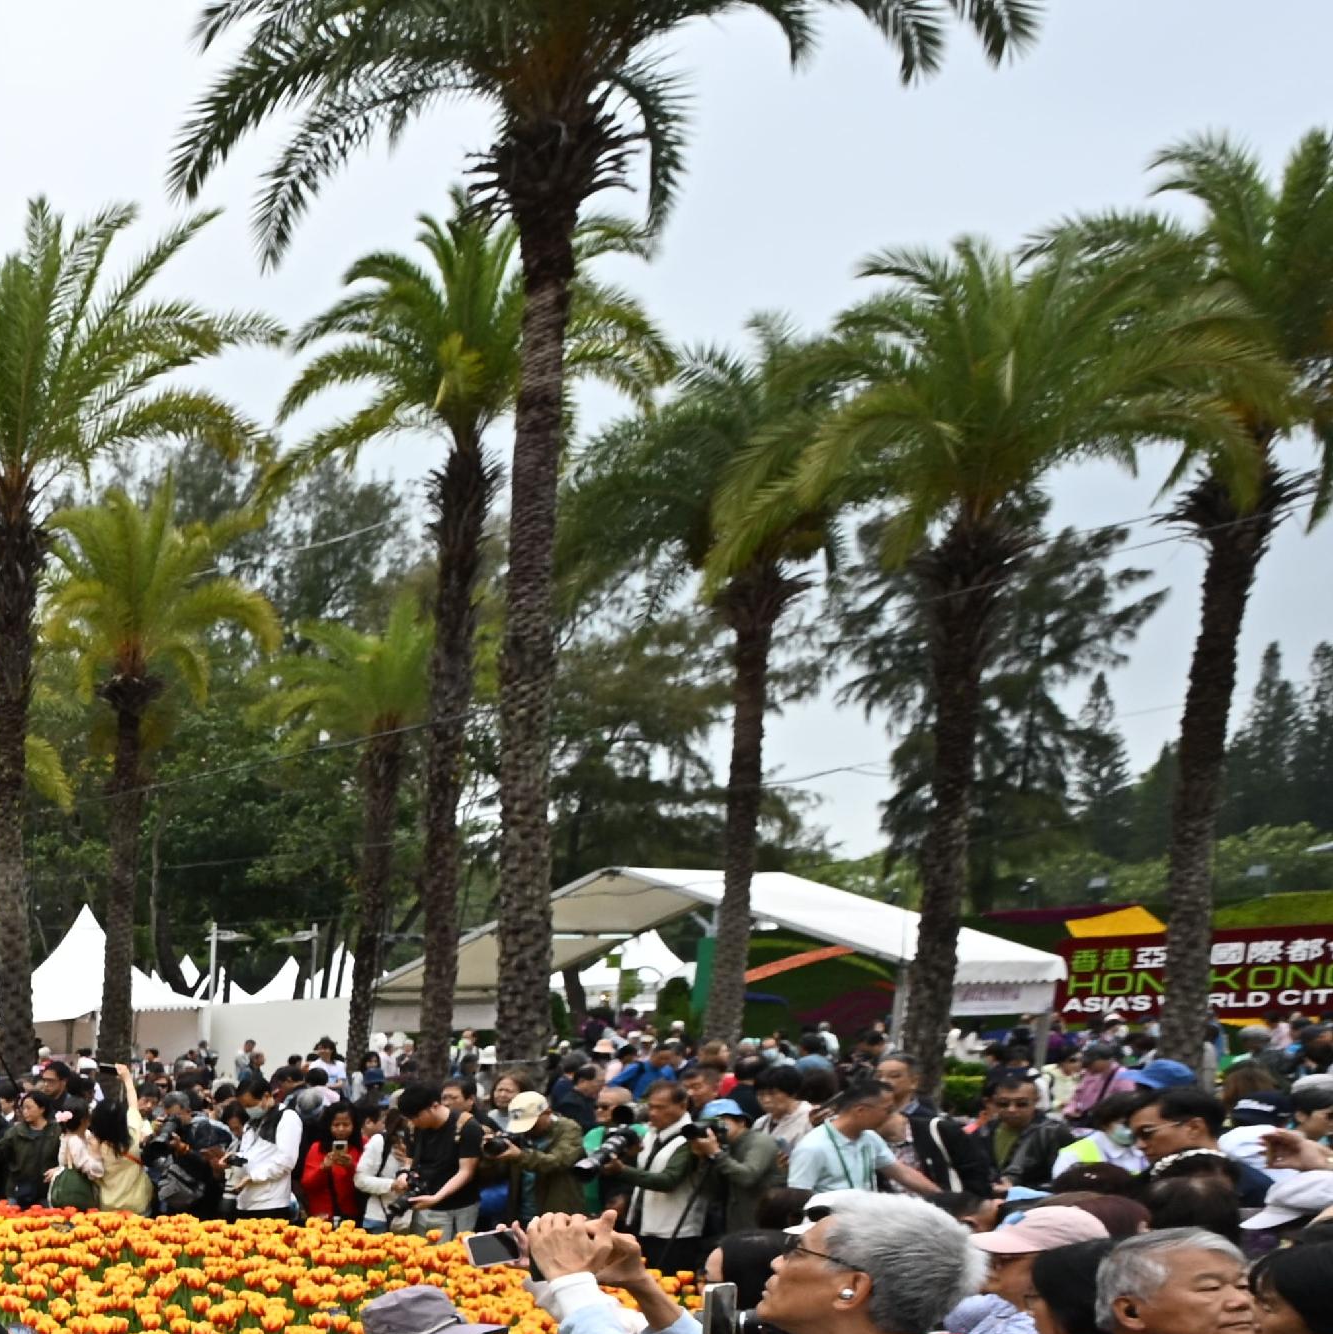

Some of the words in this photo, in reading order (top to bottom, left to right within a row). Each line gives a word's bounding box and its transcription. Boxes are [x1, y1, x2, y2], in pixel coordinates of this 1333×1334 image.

[1071, 938, 1333, 972] 香港亞國際都
[1067, 971, 1165, 996] HON
[1208, 963, 1333, 991] KON
